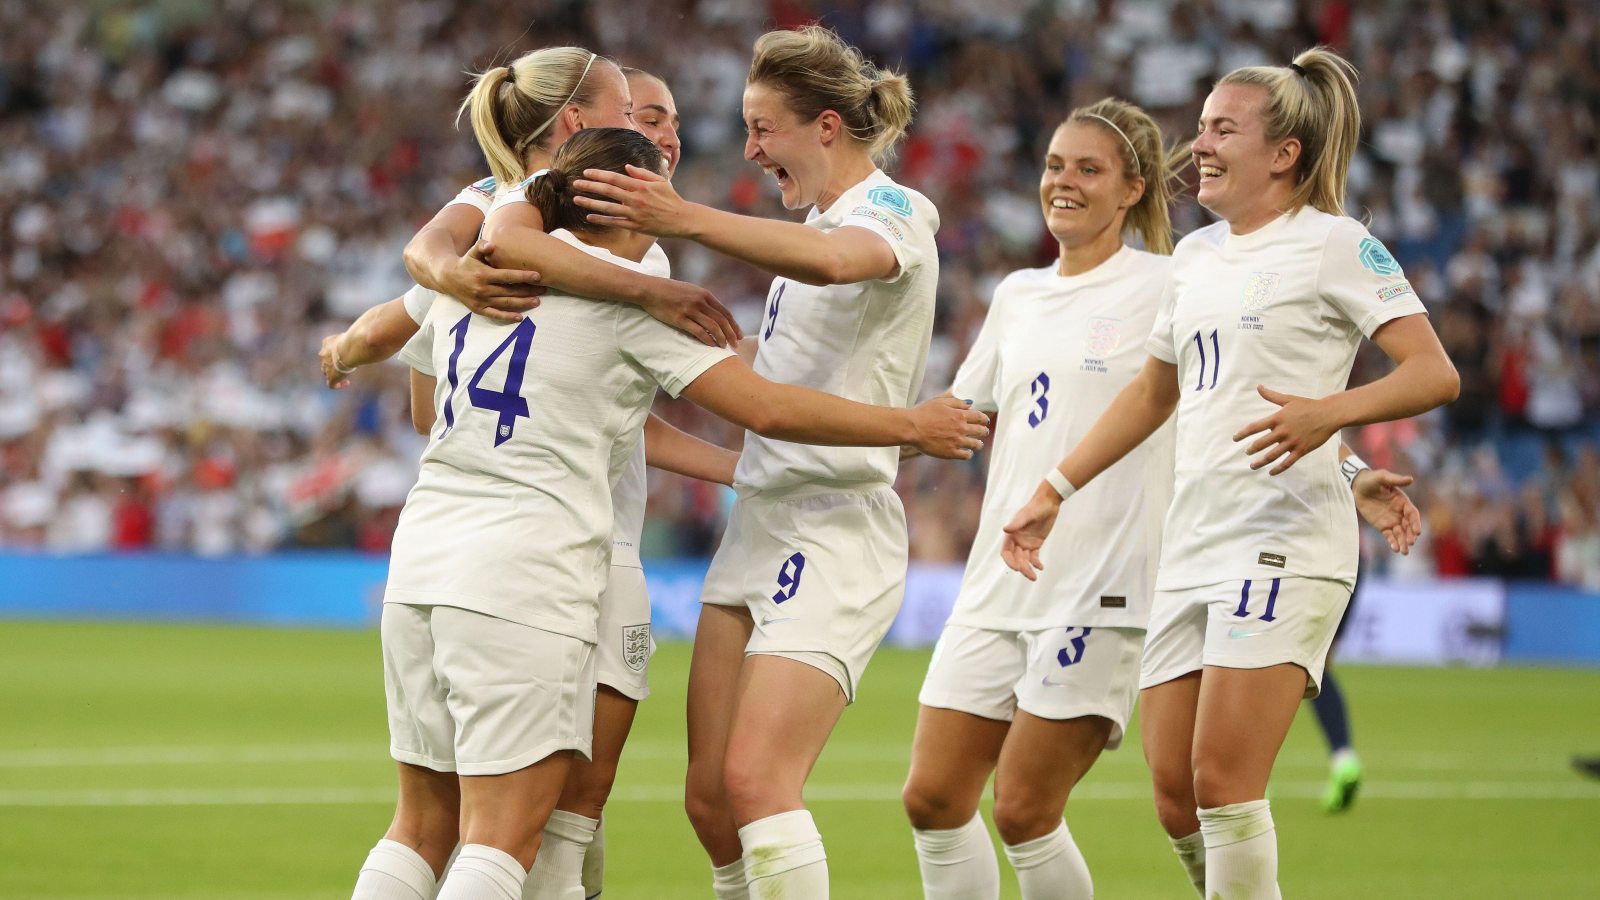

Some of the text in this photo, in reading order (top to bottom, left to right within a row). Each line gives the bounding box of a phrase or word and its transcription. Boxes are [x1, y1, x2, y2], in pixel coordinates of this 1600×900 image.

[765, 281, 786, 342] 9
[438, 311, 537, 449] 14
[1193, 328, 1220, 391] 11
[1028, 371, 1050, 429] 3
[772, 551, 806, 605] 9
[1232, 578, 1281, 623] 11
[1057, 626, 1092, 668] 3
